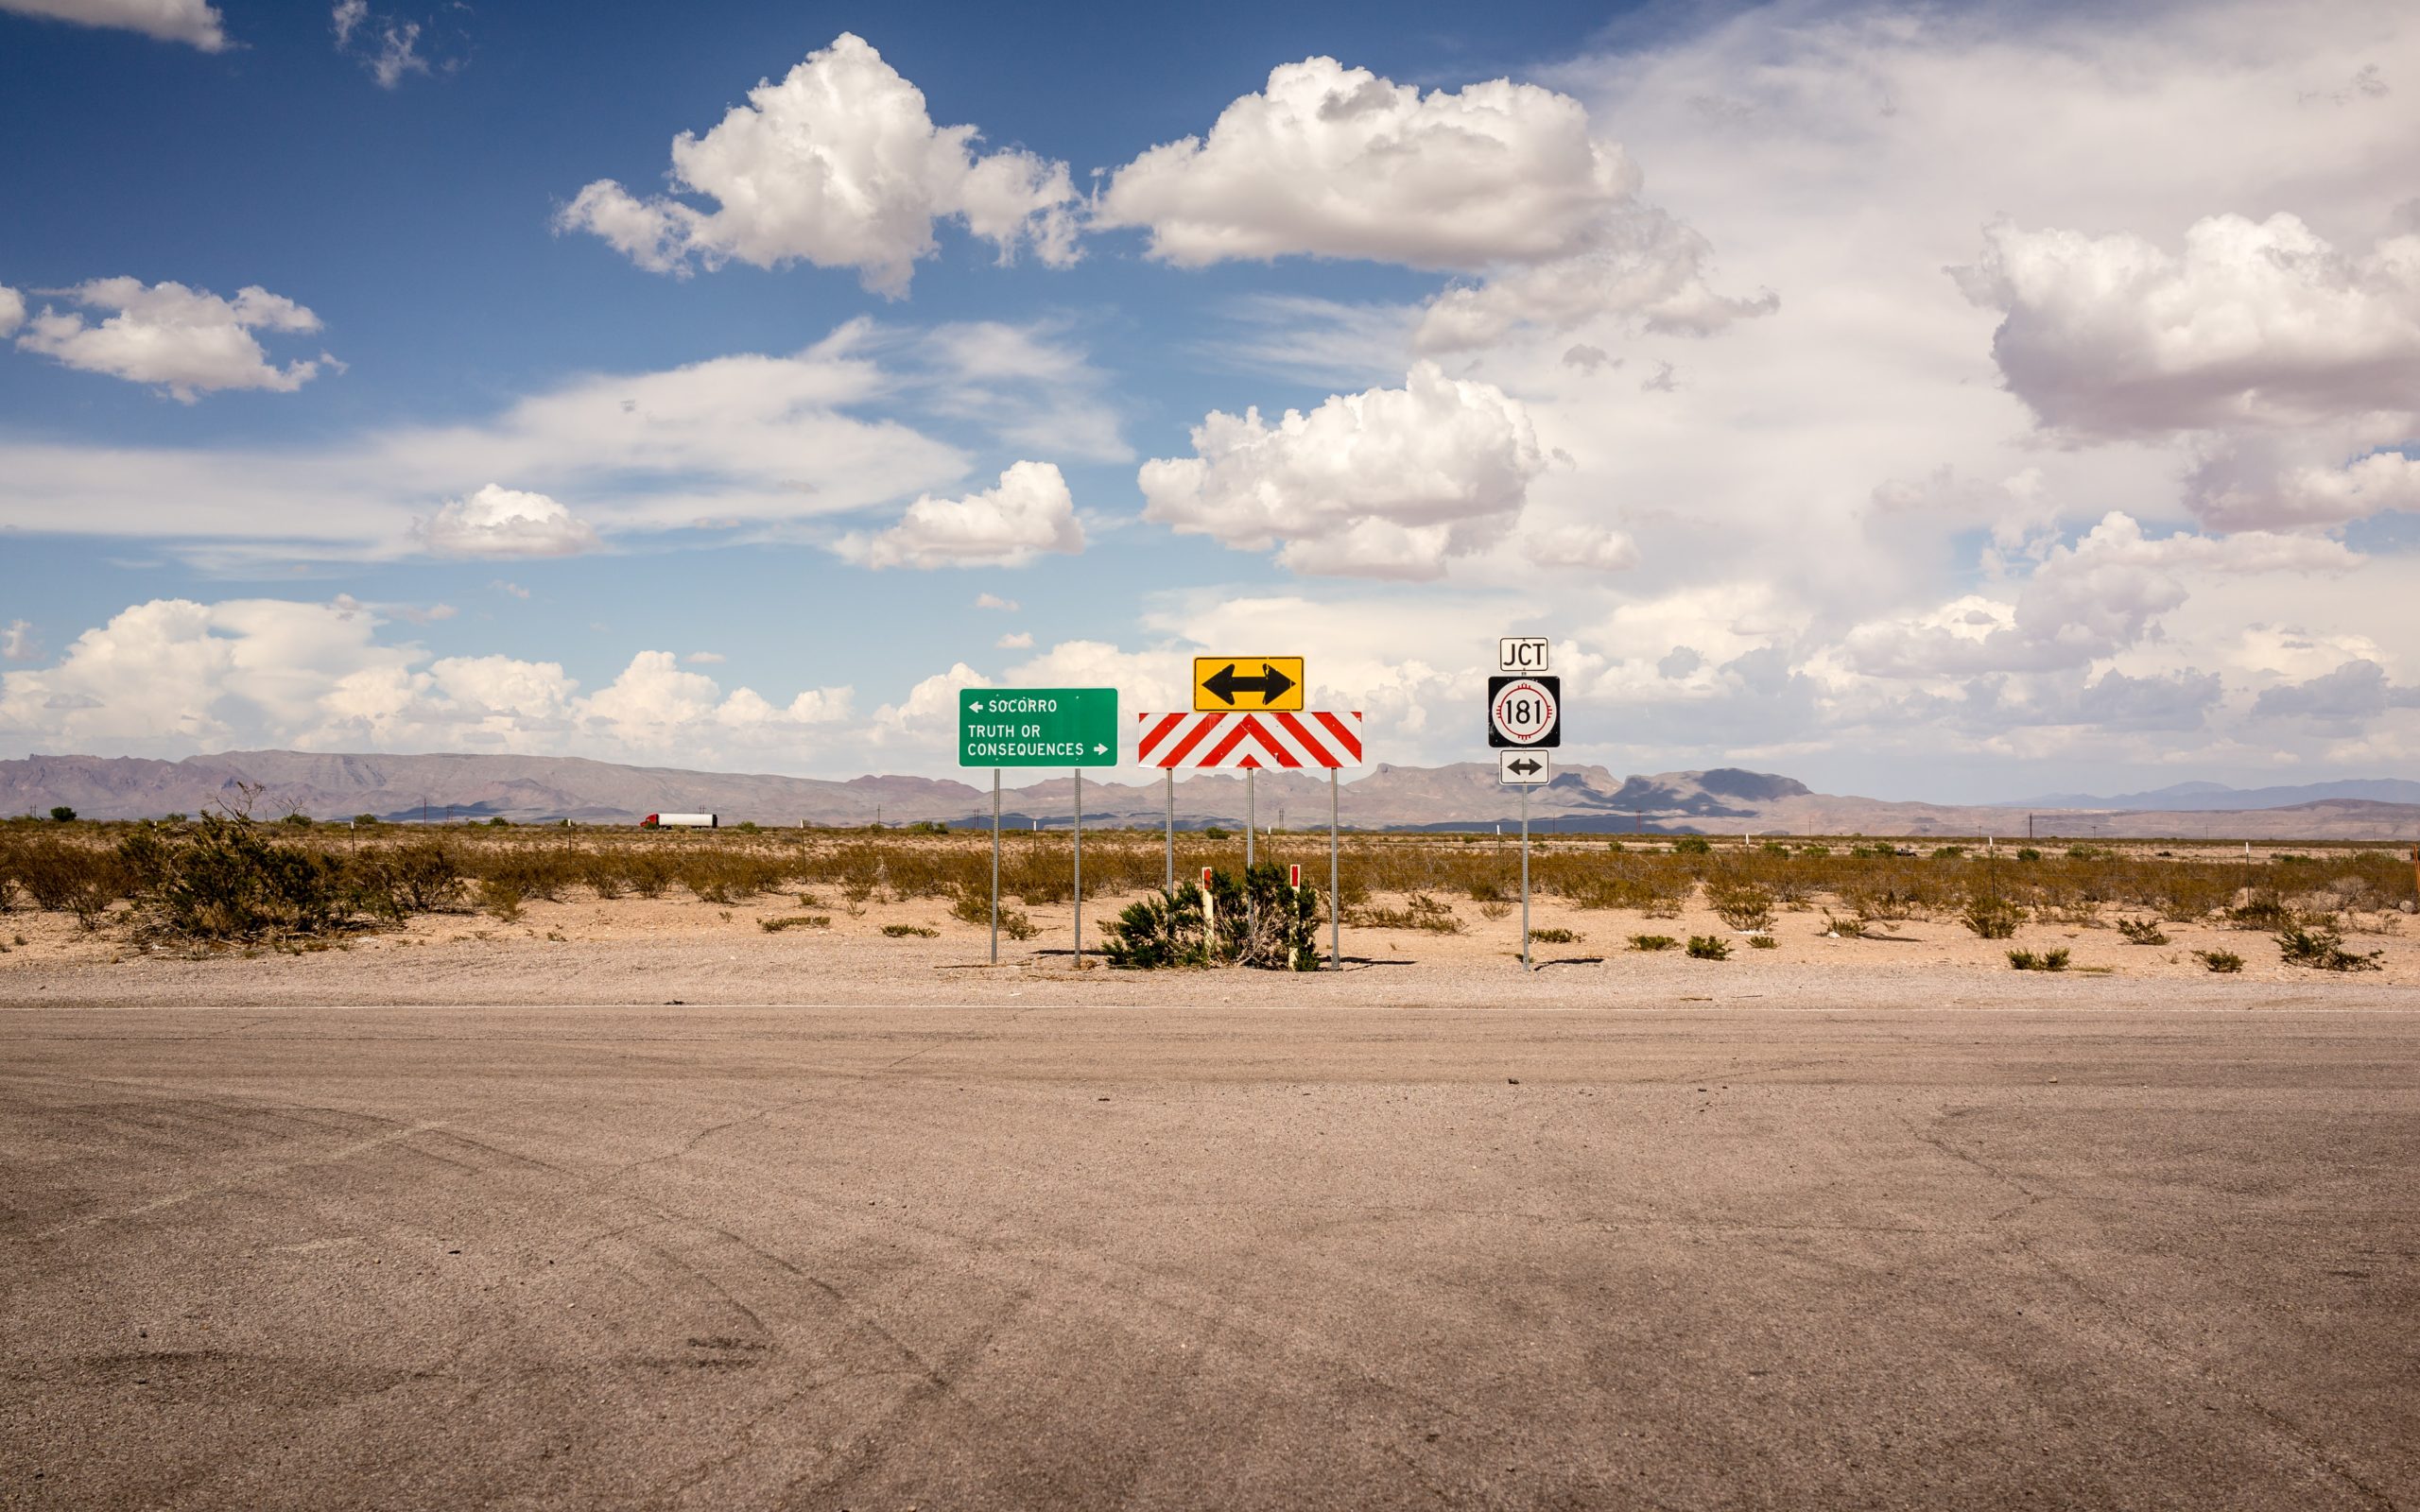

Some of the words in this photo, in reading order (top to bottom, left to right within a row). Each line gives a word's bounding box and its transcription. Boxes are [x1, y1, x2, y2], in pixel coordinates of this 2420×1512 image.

[1503, 643, 1545, 666] JCT
[989, 699, 1057, 713] SOCORRO
[1506, 699, 1540, 724] 181
[968, 725, 1014, 737] TRUTH
[1021, 725, 1040, 737] OR
[967, 743, 1084, 756] CONSEQUENCES
